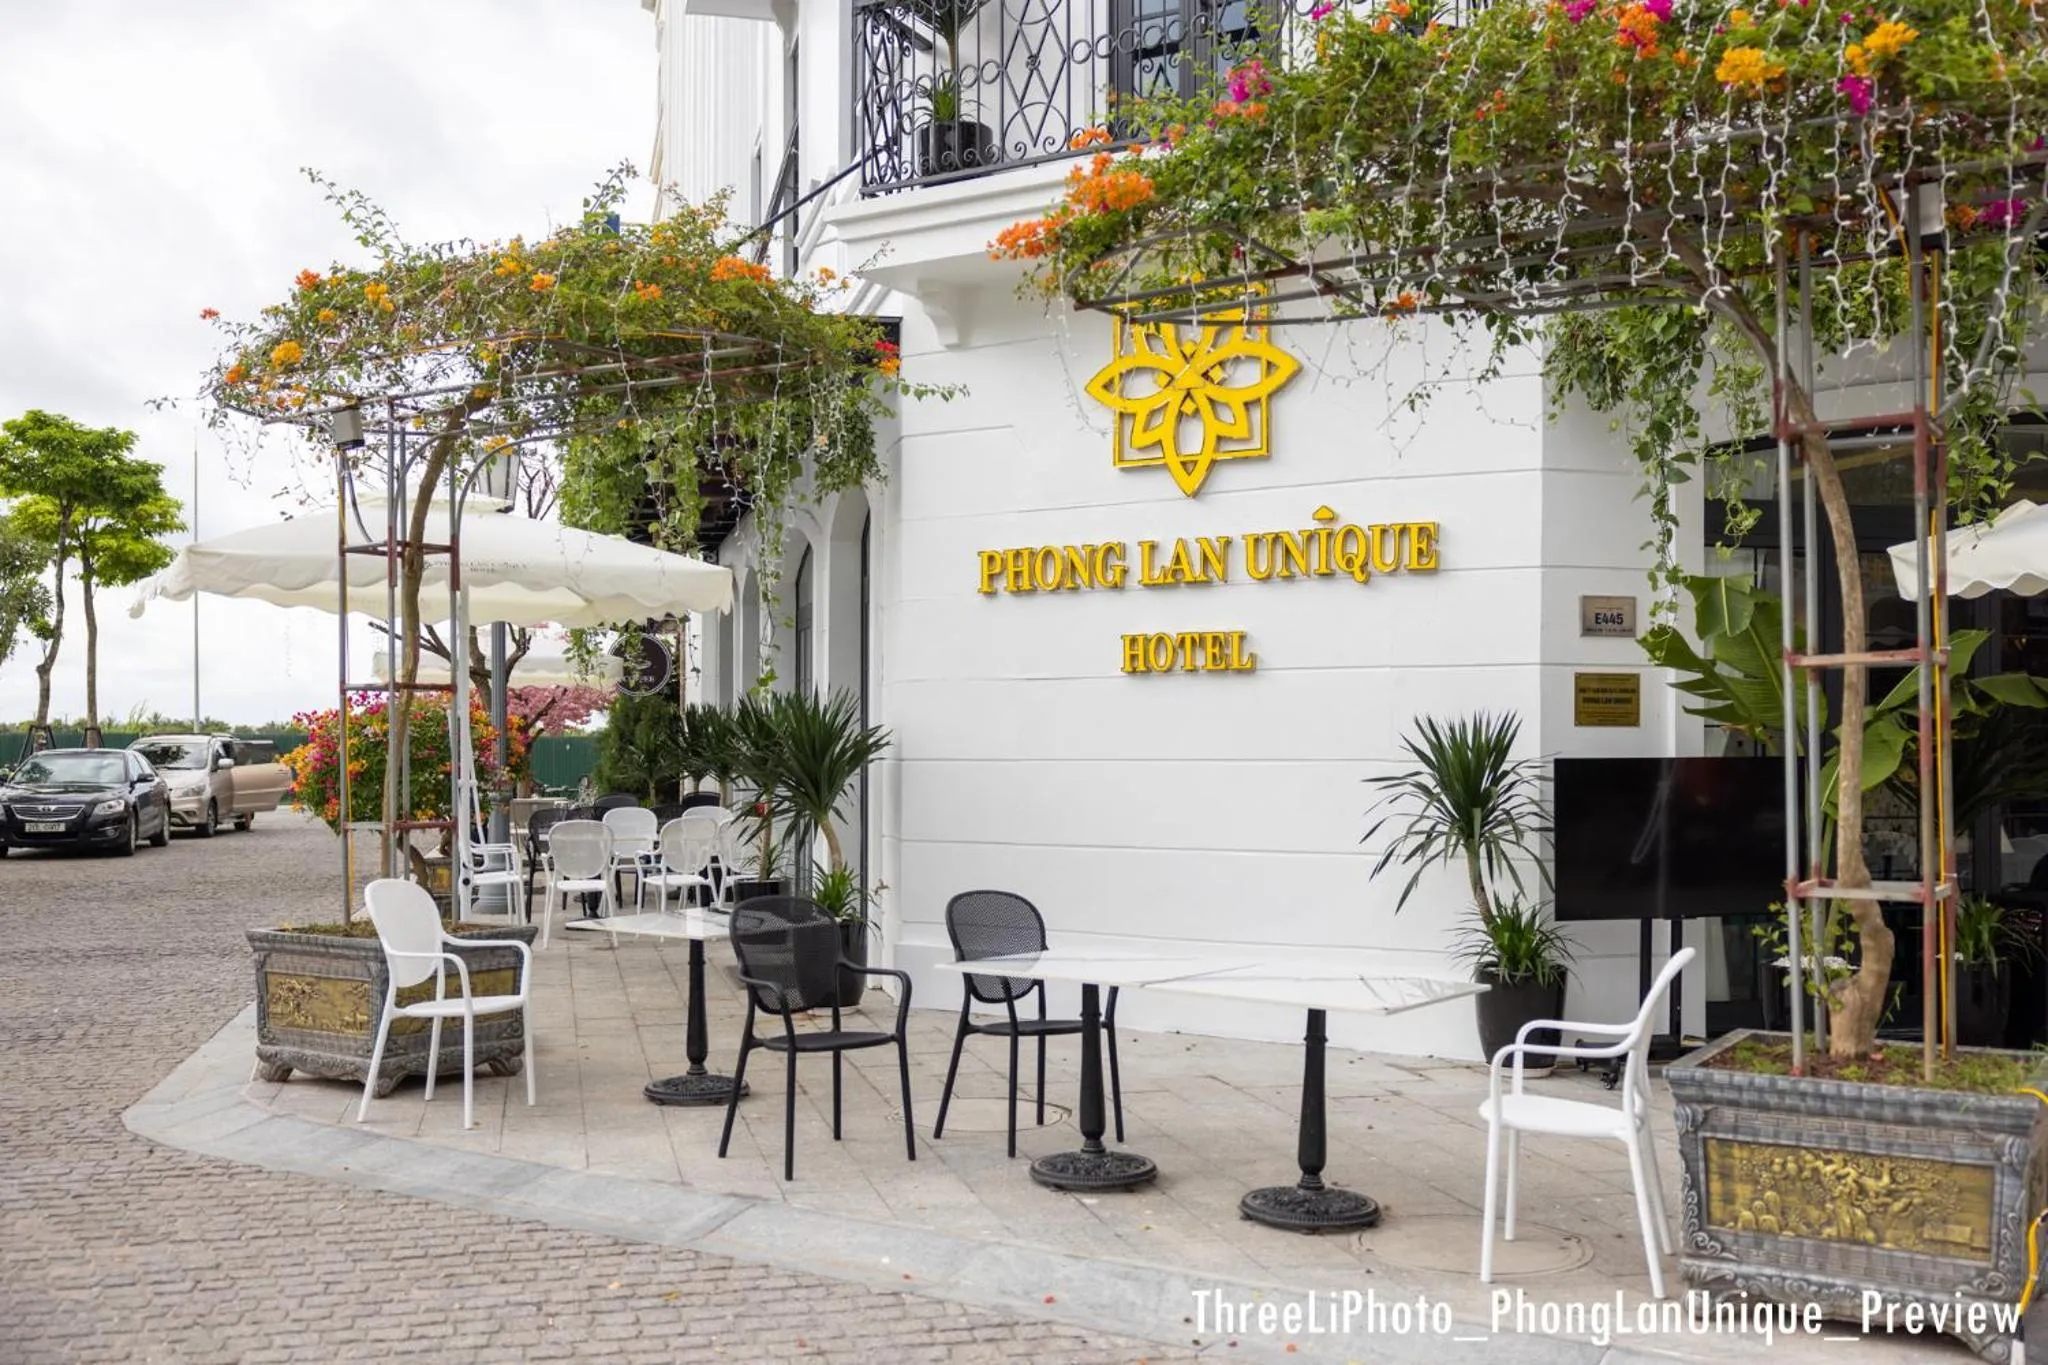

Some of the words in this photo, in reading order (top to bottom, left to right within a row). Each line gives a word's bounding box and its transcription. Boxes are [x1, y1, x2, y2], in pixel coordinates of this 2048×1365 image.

[978, 542, 1128, 595] PHONG
[1138, 536, 1232, 587] LAN
[1594, 612, 1624, 625] E445
[1121, 630, 1256, 673] HOTEL
